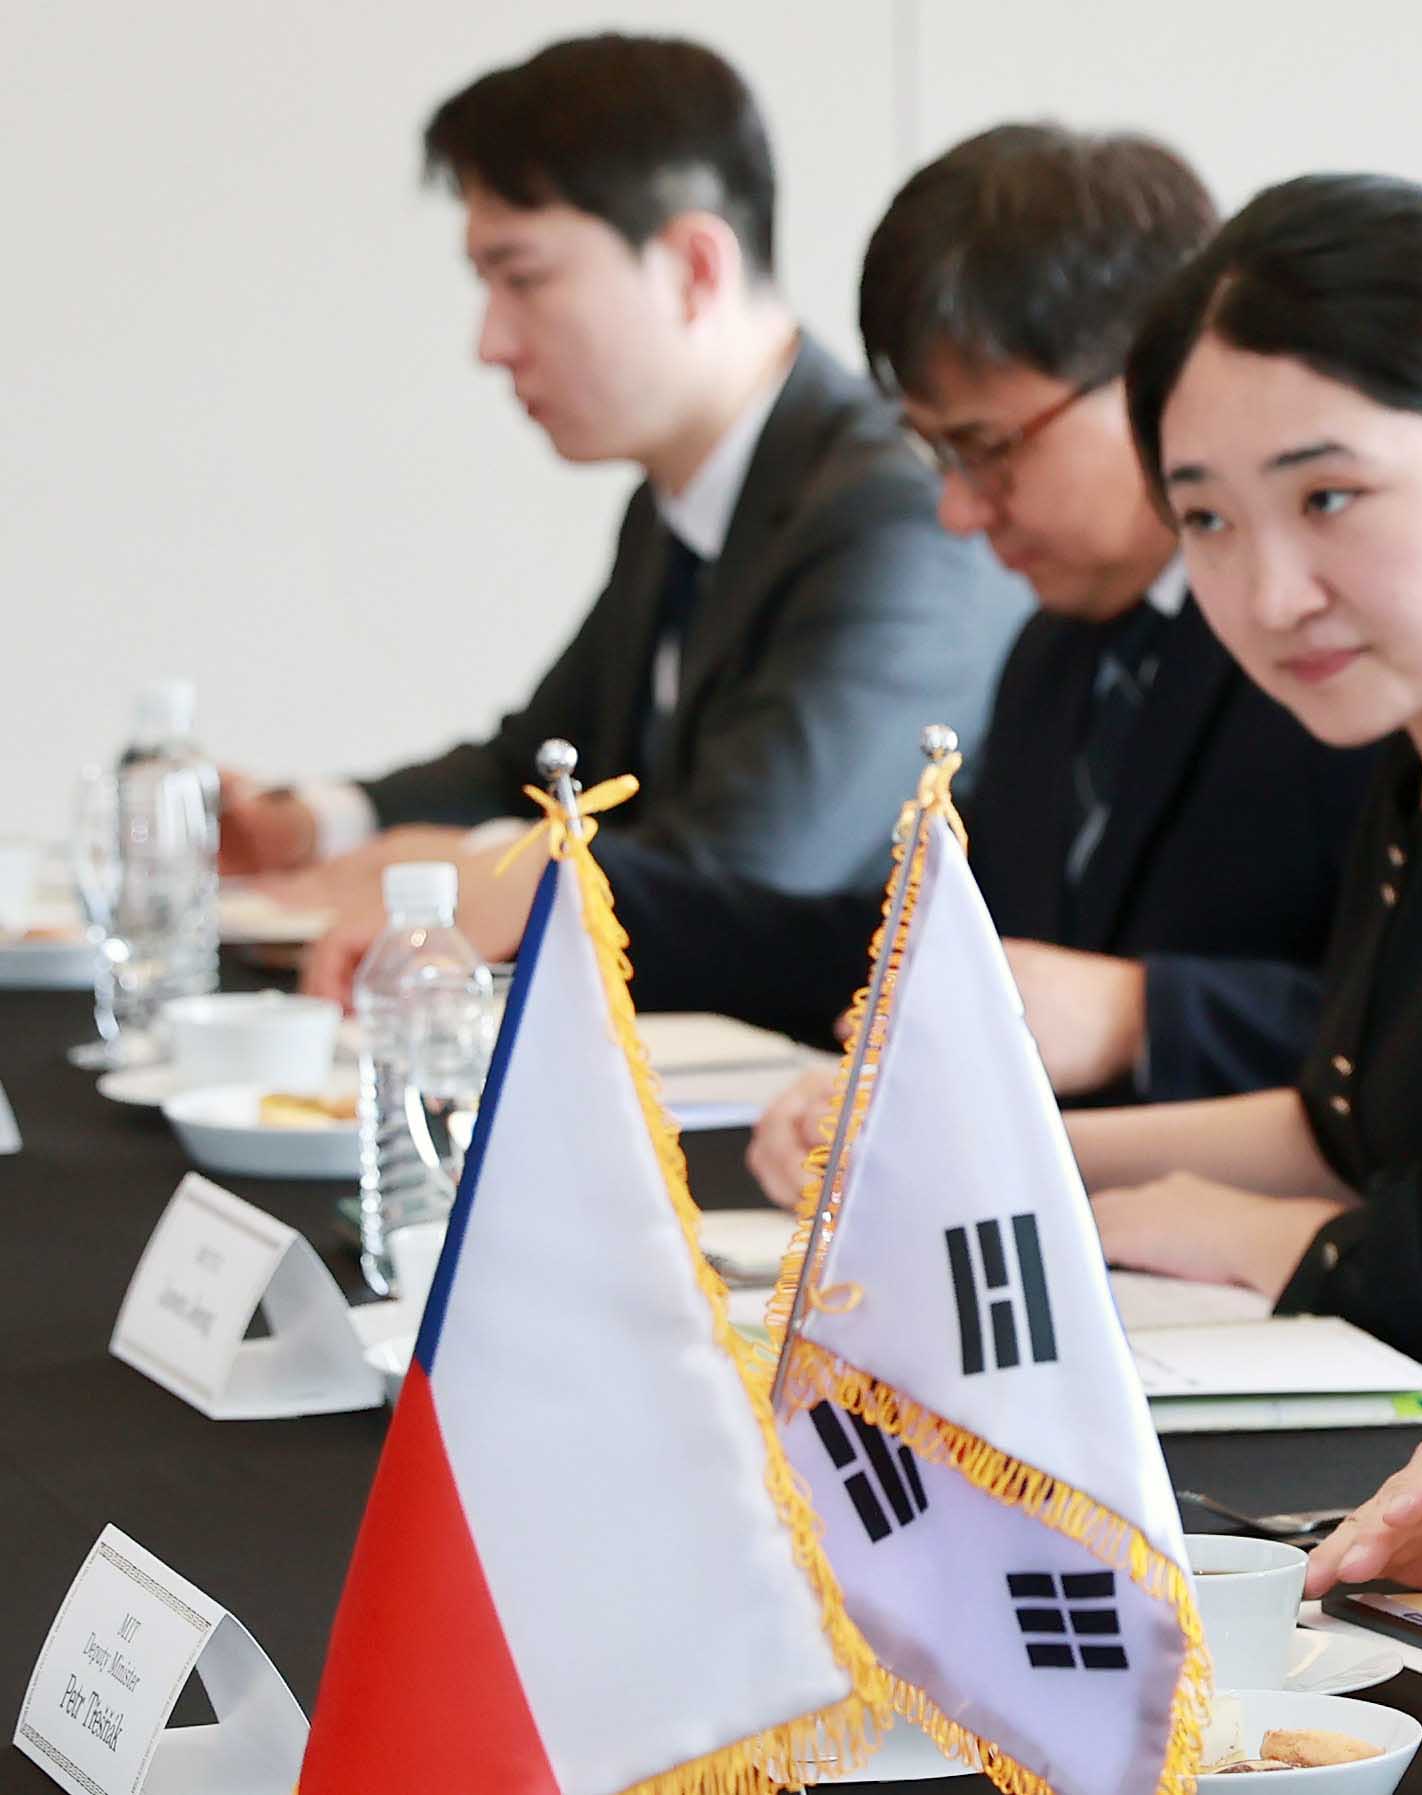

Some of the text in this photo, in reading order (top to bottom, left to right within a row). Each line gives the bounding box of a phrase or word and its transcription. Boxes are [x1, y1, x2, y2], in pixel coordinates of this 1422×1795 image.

[117, 1613, 141, 1643] MIT
[83, 1632, 140, 1692] Deputy Minister
[60, 1673, 86, 1719] Petr
